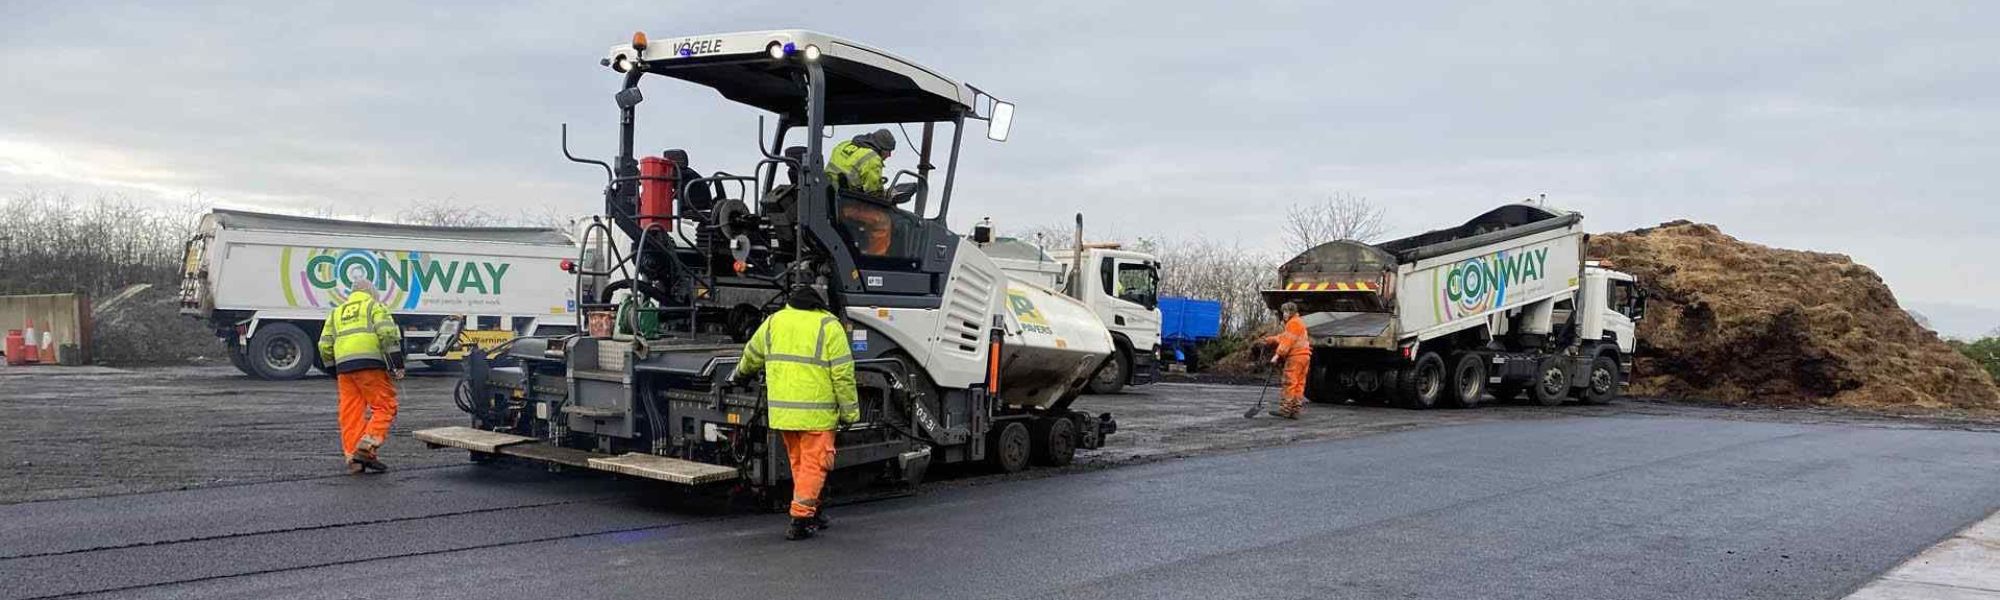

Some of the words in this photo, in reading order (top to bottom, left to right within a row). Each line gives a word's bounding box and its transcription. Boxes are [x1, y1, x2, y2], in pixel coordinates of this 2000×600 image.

[673, 38, 722, 56] VÖGELE
[306, 255, 511, 295] CONWAY
[1447, 246, 1548, 302] CONWAY
